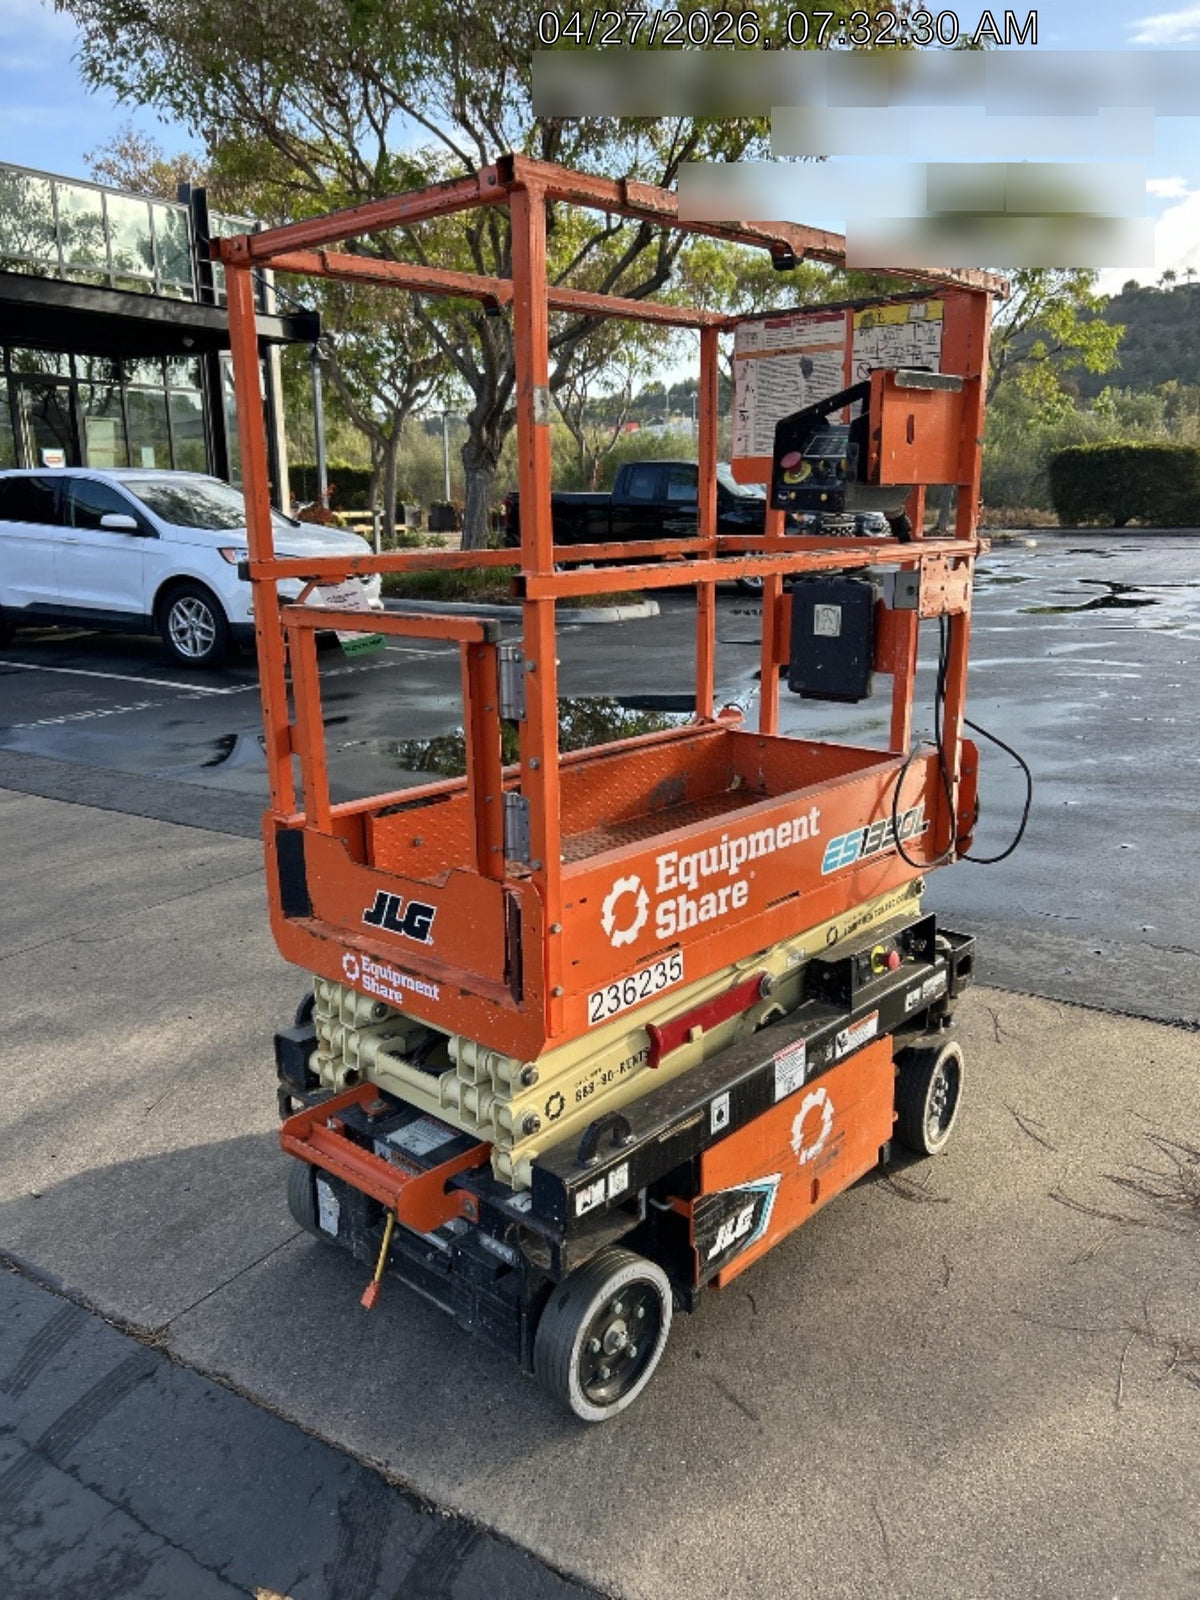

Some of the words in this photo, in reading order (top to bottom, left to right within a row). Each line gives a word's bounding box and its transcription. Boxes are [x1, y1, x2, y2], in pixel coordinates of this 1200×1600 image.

[655, 805, 821, 895] Equipment
[362, 889, 437, 943] JLG
[655, 879, 749, 940] Share
[361, 955, 440, 1001] Equipment
[362, 976, 403, 1004] Share
[591, 954, 683, 1022] 236235
[707, 1203, 755, 1261] JLG
